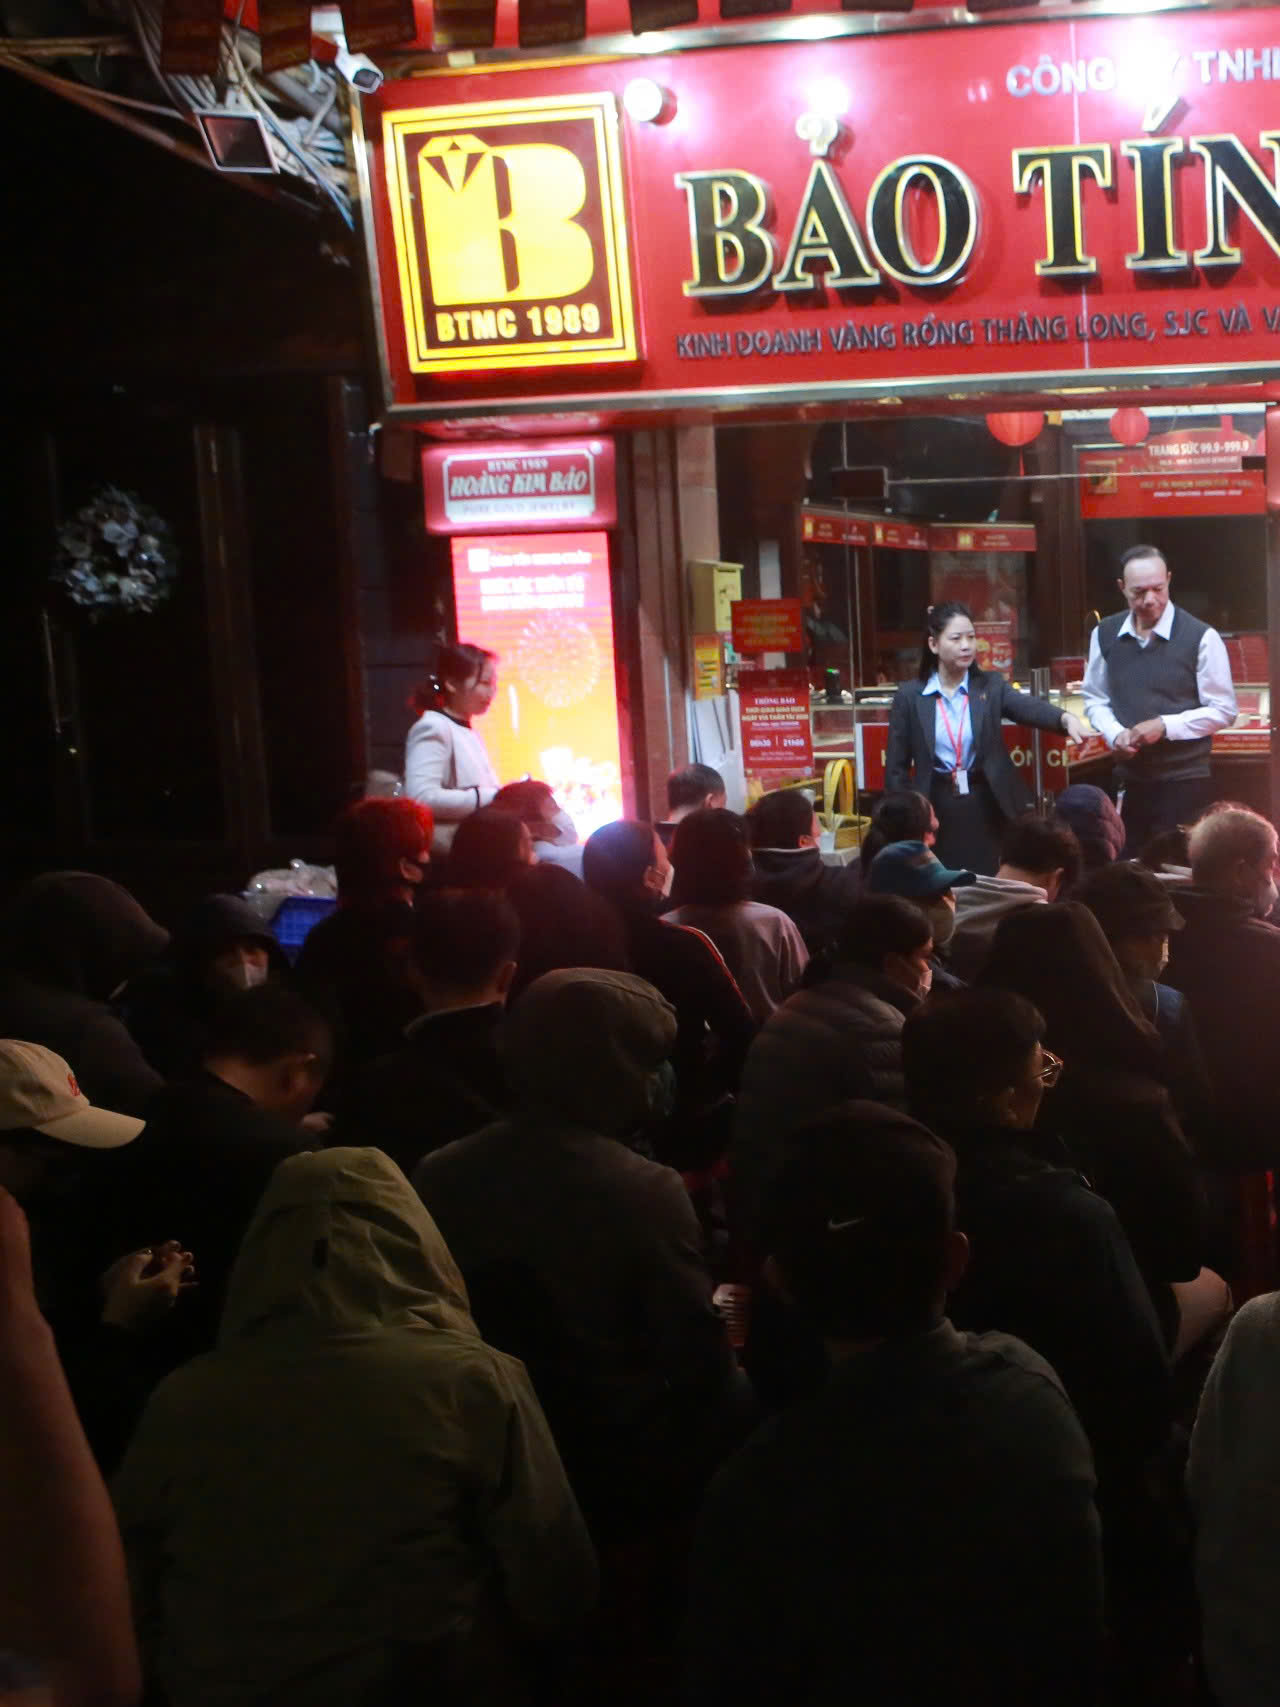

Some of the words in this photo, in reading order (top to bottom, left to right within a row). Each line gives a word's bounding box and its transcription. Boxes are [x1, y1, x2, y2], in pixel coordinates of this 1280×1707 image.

[1006, 54, 1116, 97] CÔNG
[675, 113, 978, 297] BẢO
[436, 306, 518, 342] BTMC
[526, 303, 600, 335] 1989
[676, 331, 731, 359] KINH
[735, 327, 822, 356] DOANH
[828, 320, 896, 351] VÀNG
[982, 311, 1067, 344] THĂNG
[1075, 312, 1155, 342] LONG,
[1164, 309, 1210, 337] SJC
[1217, 300, 1252, 334] VÀ
[450, 470, 512, 497] HOÀNG
[512, 472, 547, 494] KIM
